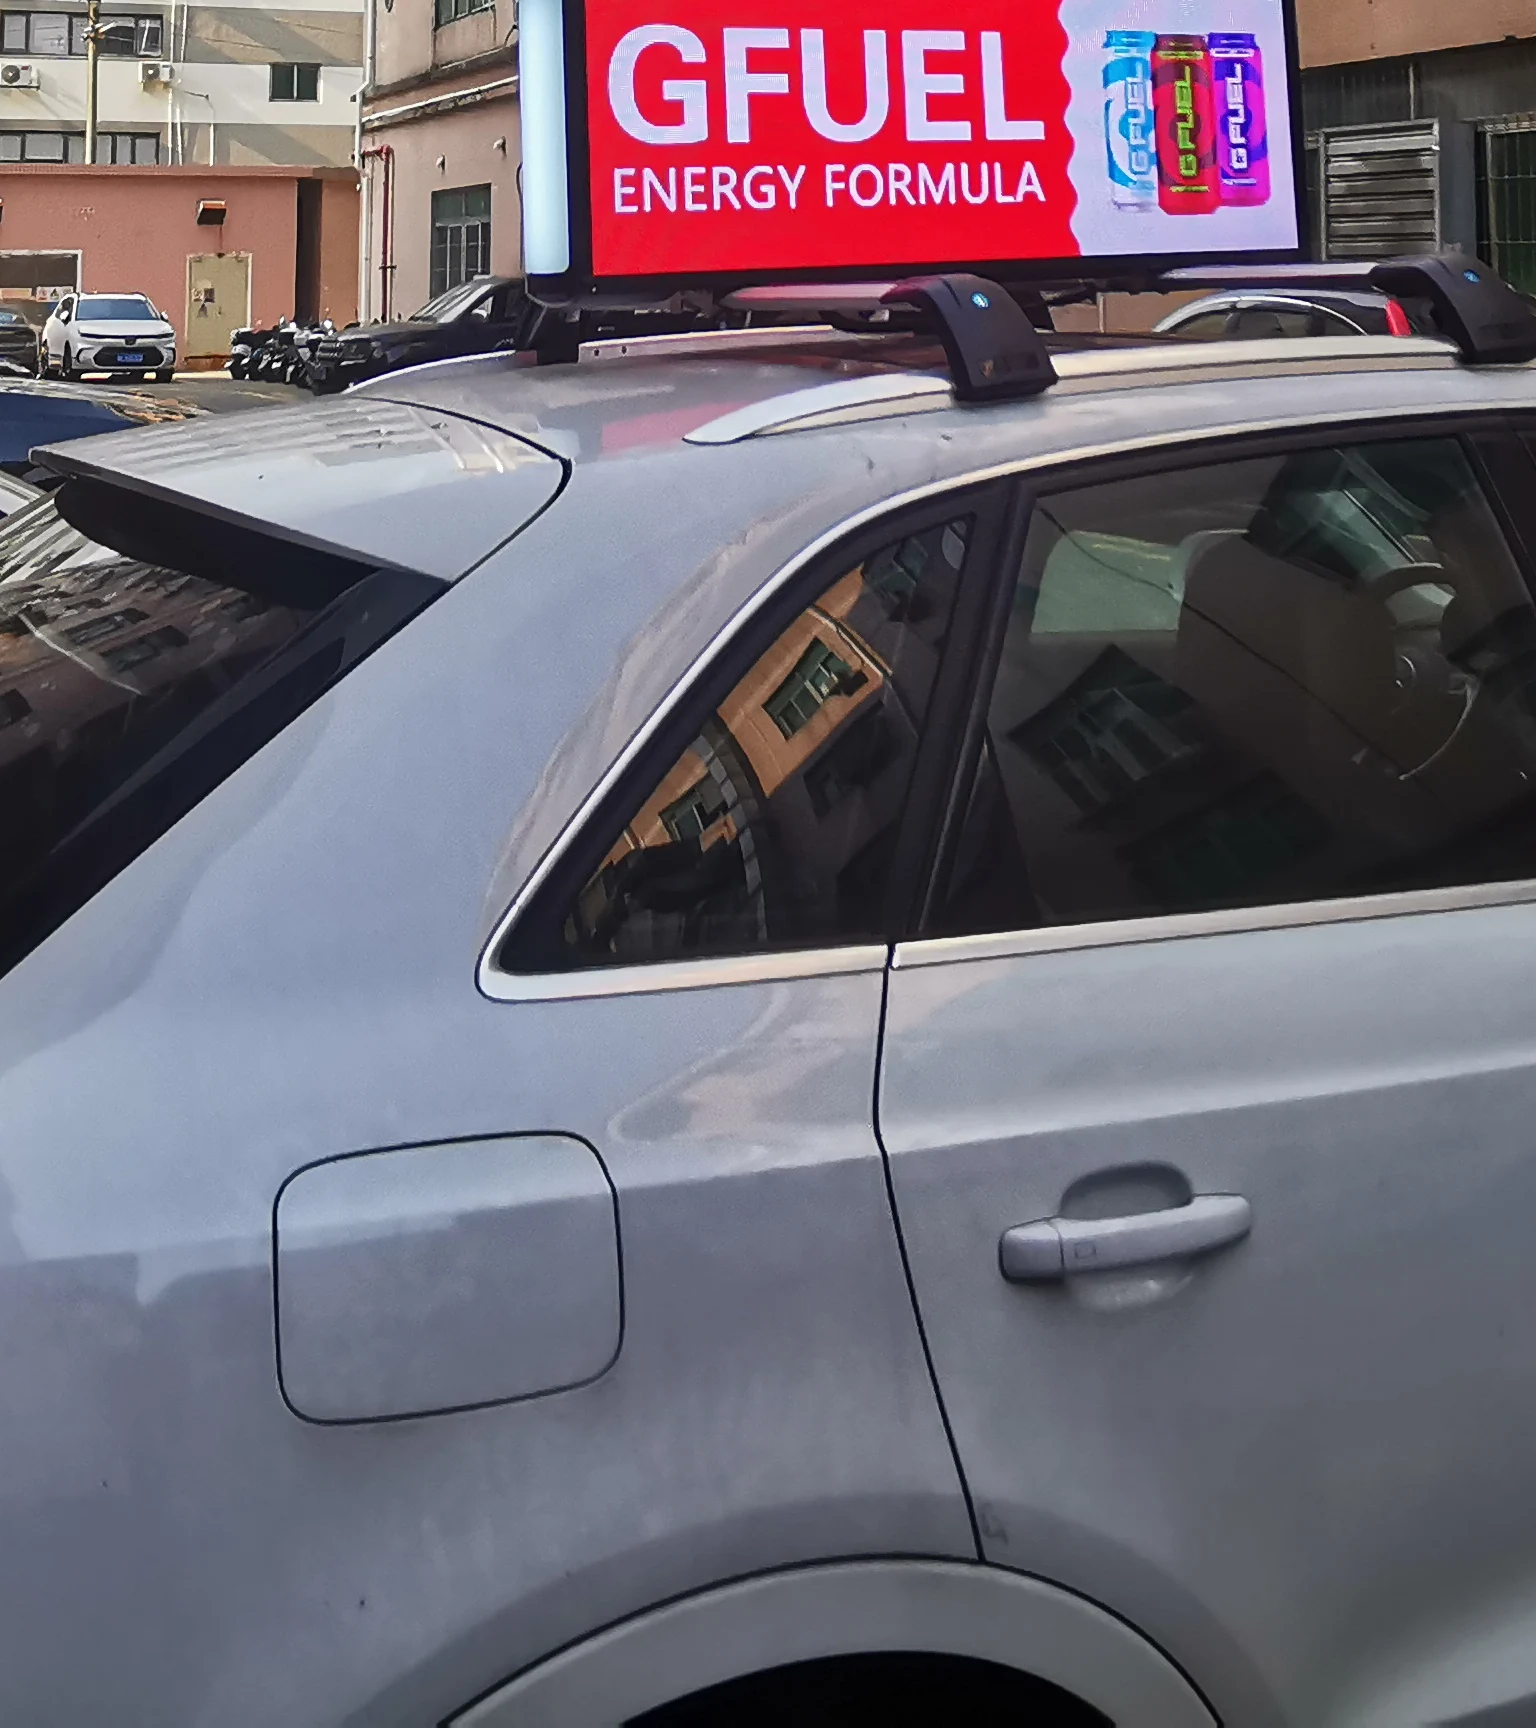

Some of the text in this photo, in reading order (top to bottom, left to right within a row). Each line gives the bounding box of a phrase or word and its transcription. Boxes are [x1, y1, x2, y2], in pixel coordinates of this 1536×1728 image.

[607, 24, 1045, 145] GFUEL
[613, 161, 1046, 213] ENERGY FORMULA
